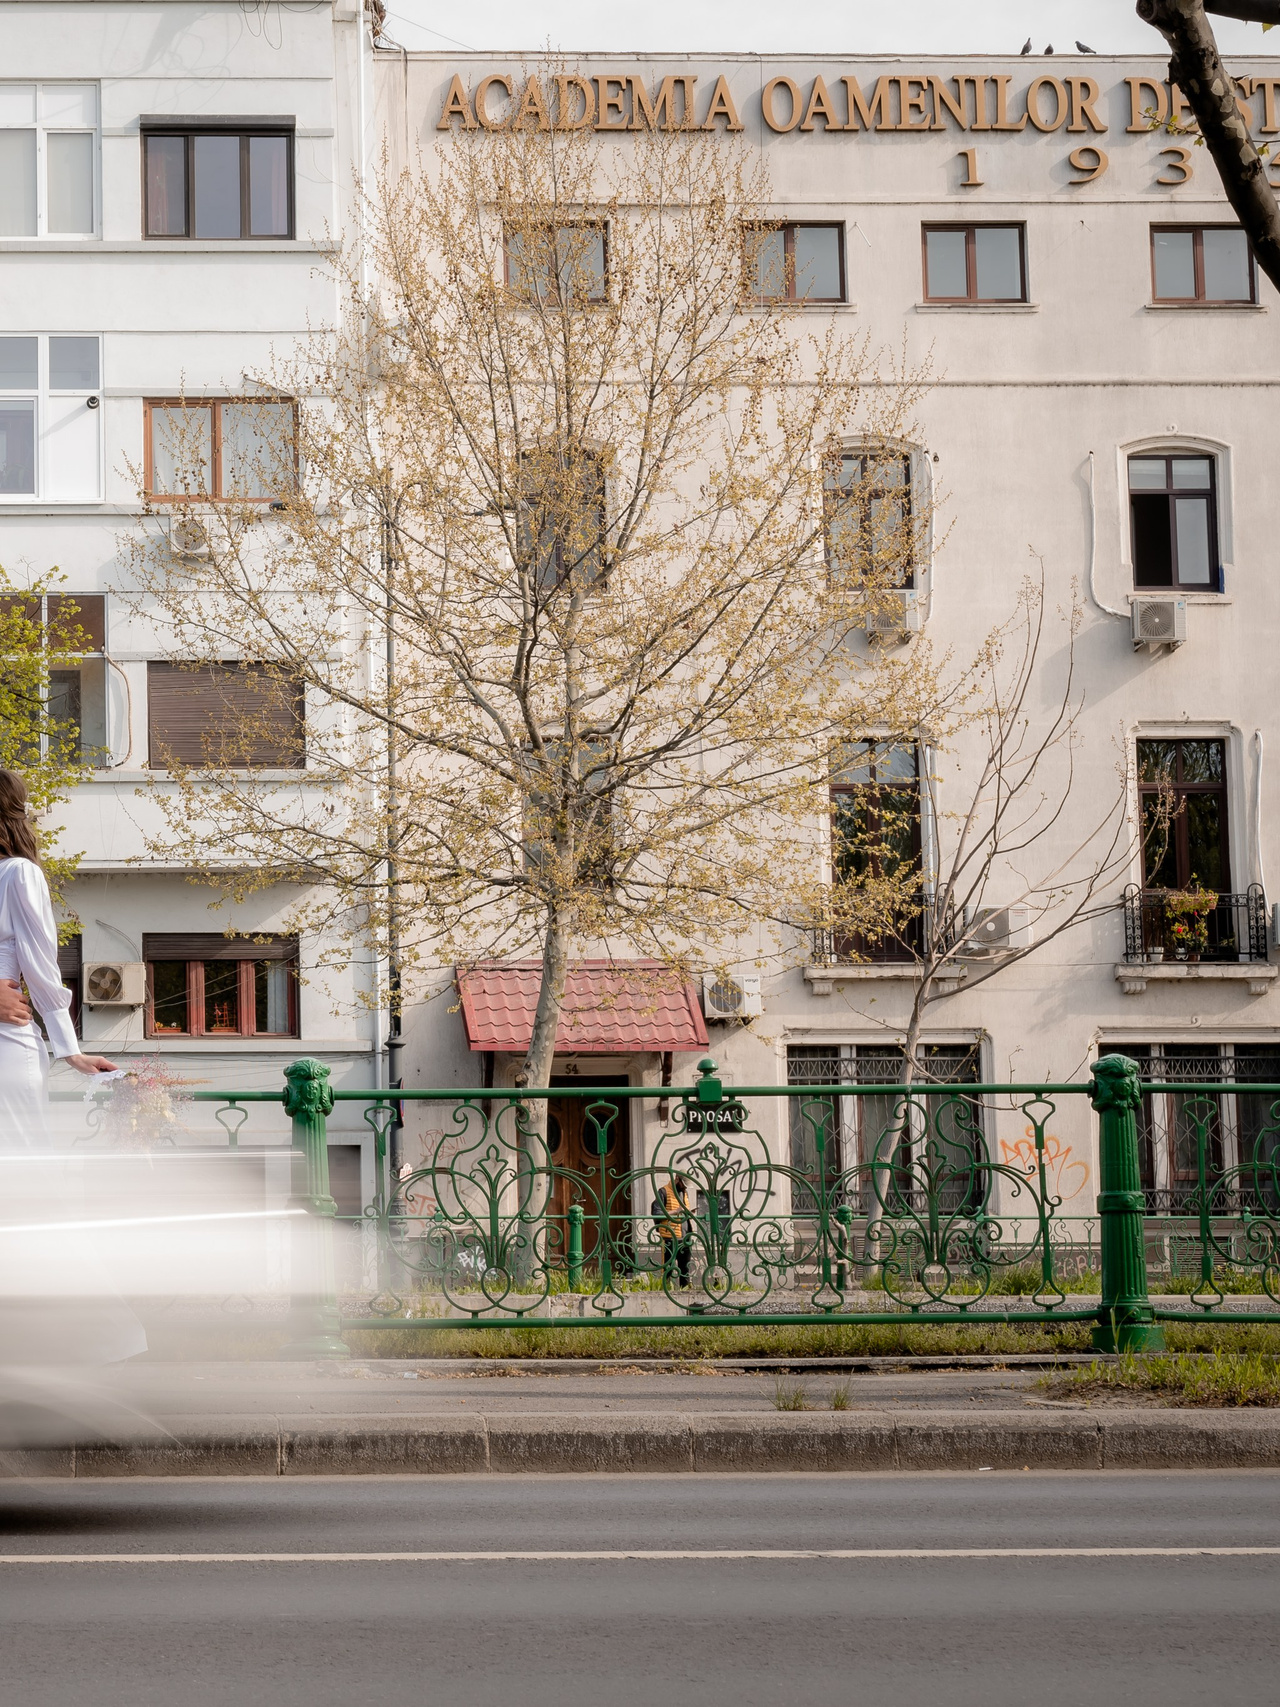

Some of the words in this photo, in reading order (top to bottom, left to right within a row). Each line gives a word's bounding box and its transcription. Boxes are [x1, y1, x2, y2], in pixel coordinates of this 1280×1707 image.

[436, 73, 745, 131] ACADEMIA
[762, 74, 1109, 133] OAMENILOR
[565, 1063, 579, 1075] 54
